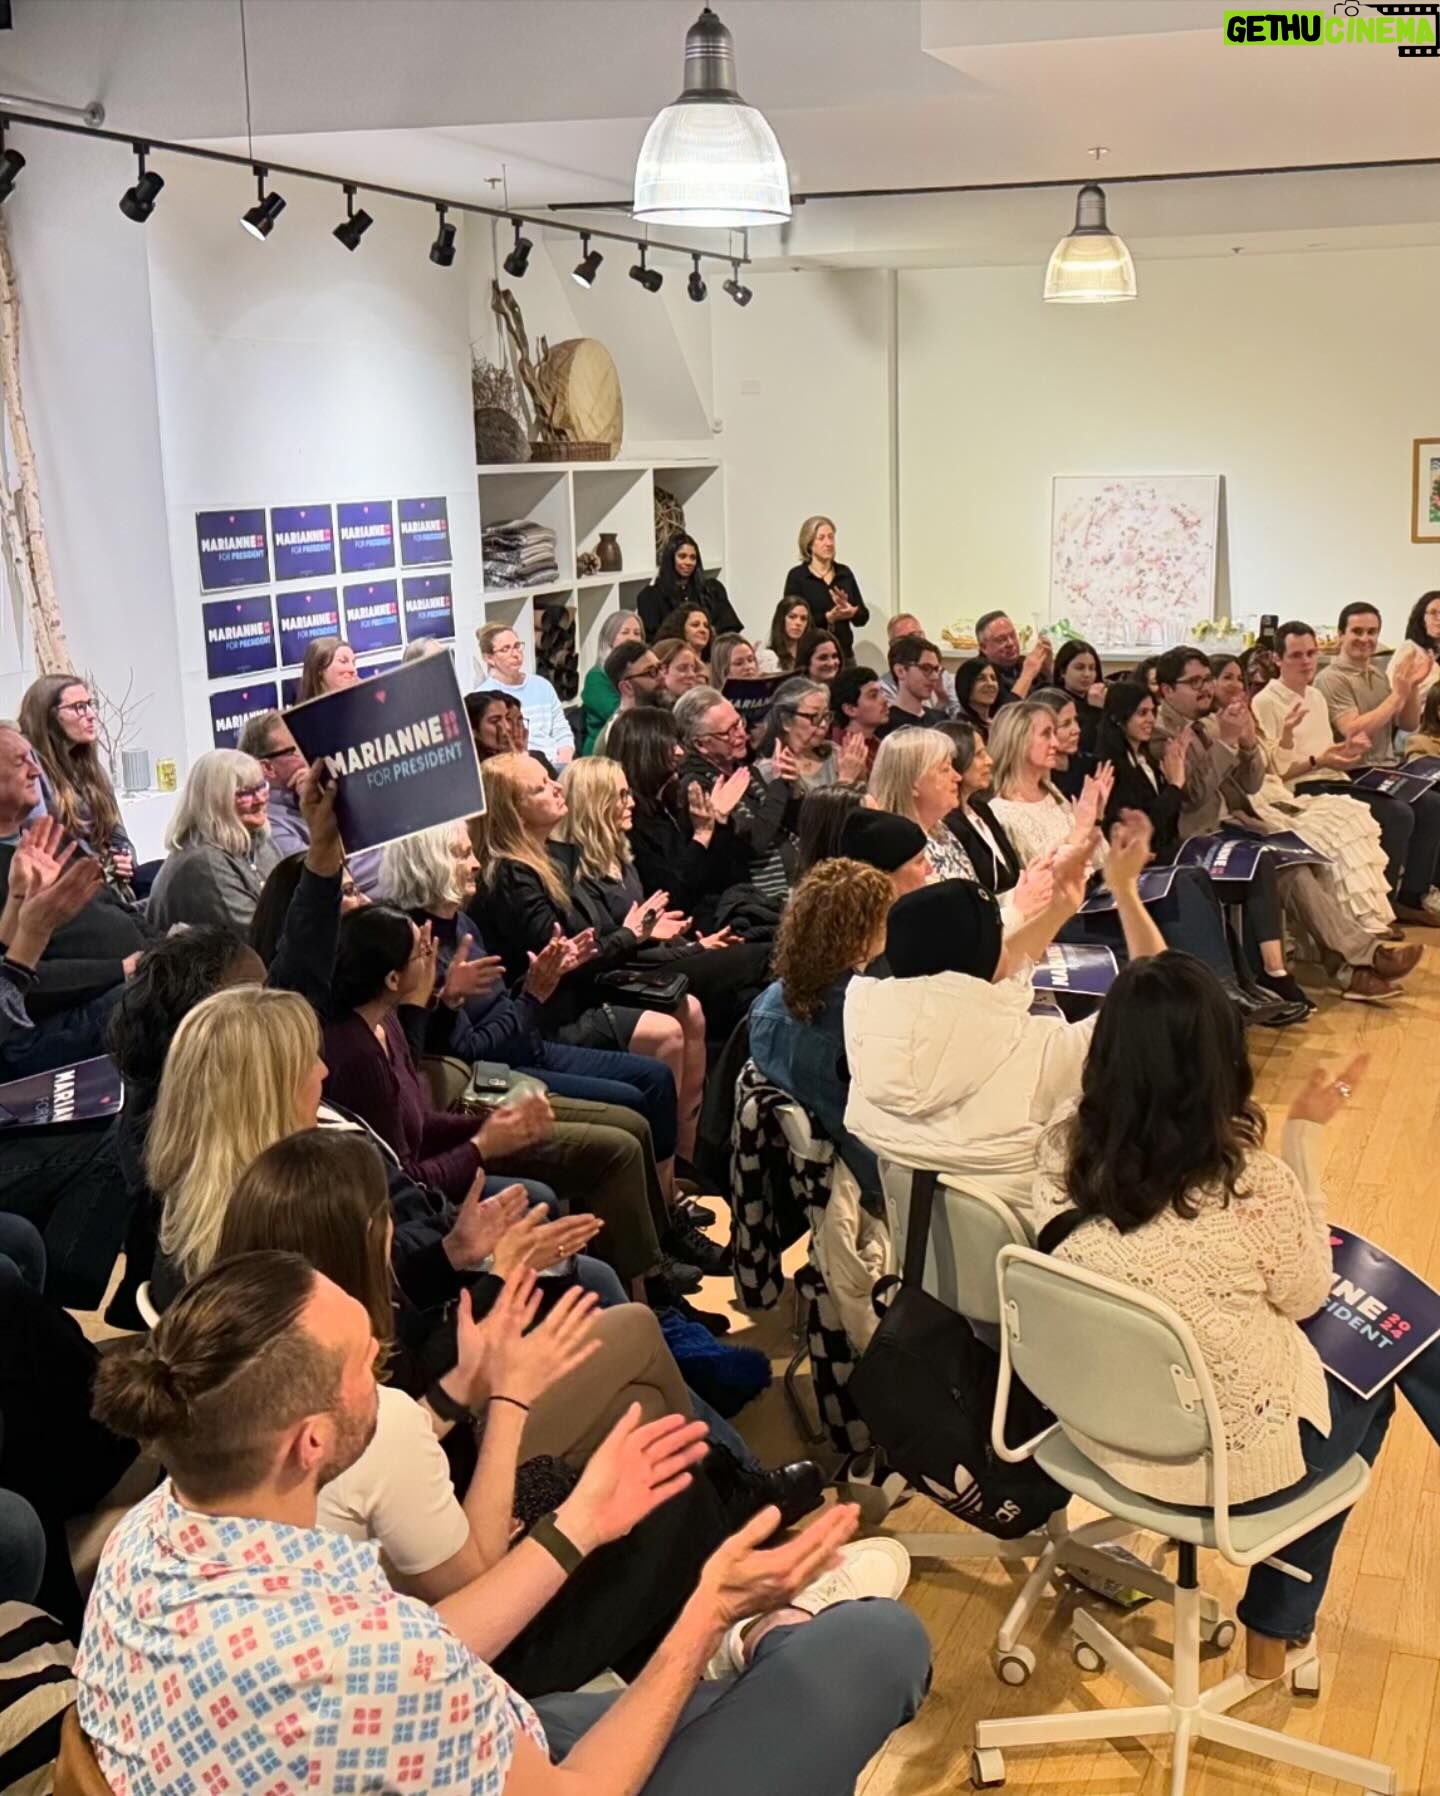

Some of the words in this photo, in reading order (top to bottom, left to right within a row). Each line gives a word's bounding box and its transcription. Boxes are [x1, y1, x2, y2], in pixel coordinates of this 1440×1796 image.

[201, 535, 256, 552] MARIANNE
[275, 529, 324, 546] MARIANNE
[281, 612, 330, 631] MARIANNE
[208, 622, 264, 643] MARIANNE
[325, 714, 444, 779] MARIANNE
[367, 768, 392, 788] FOR
[393, 742, 464, 781] PRESIDENT
